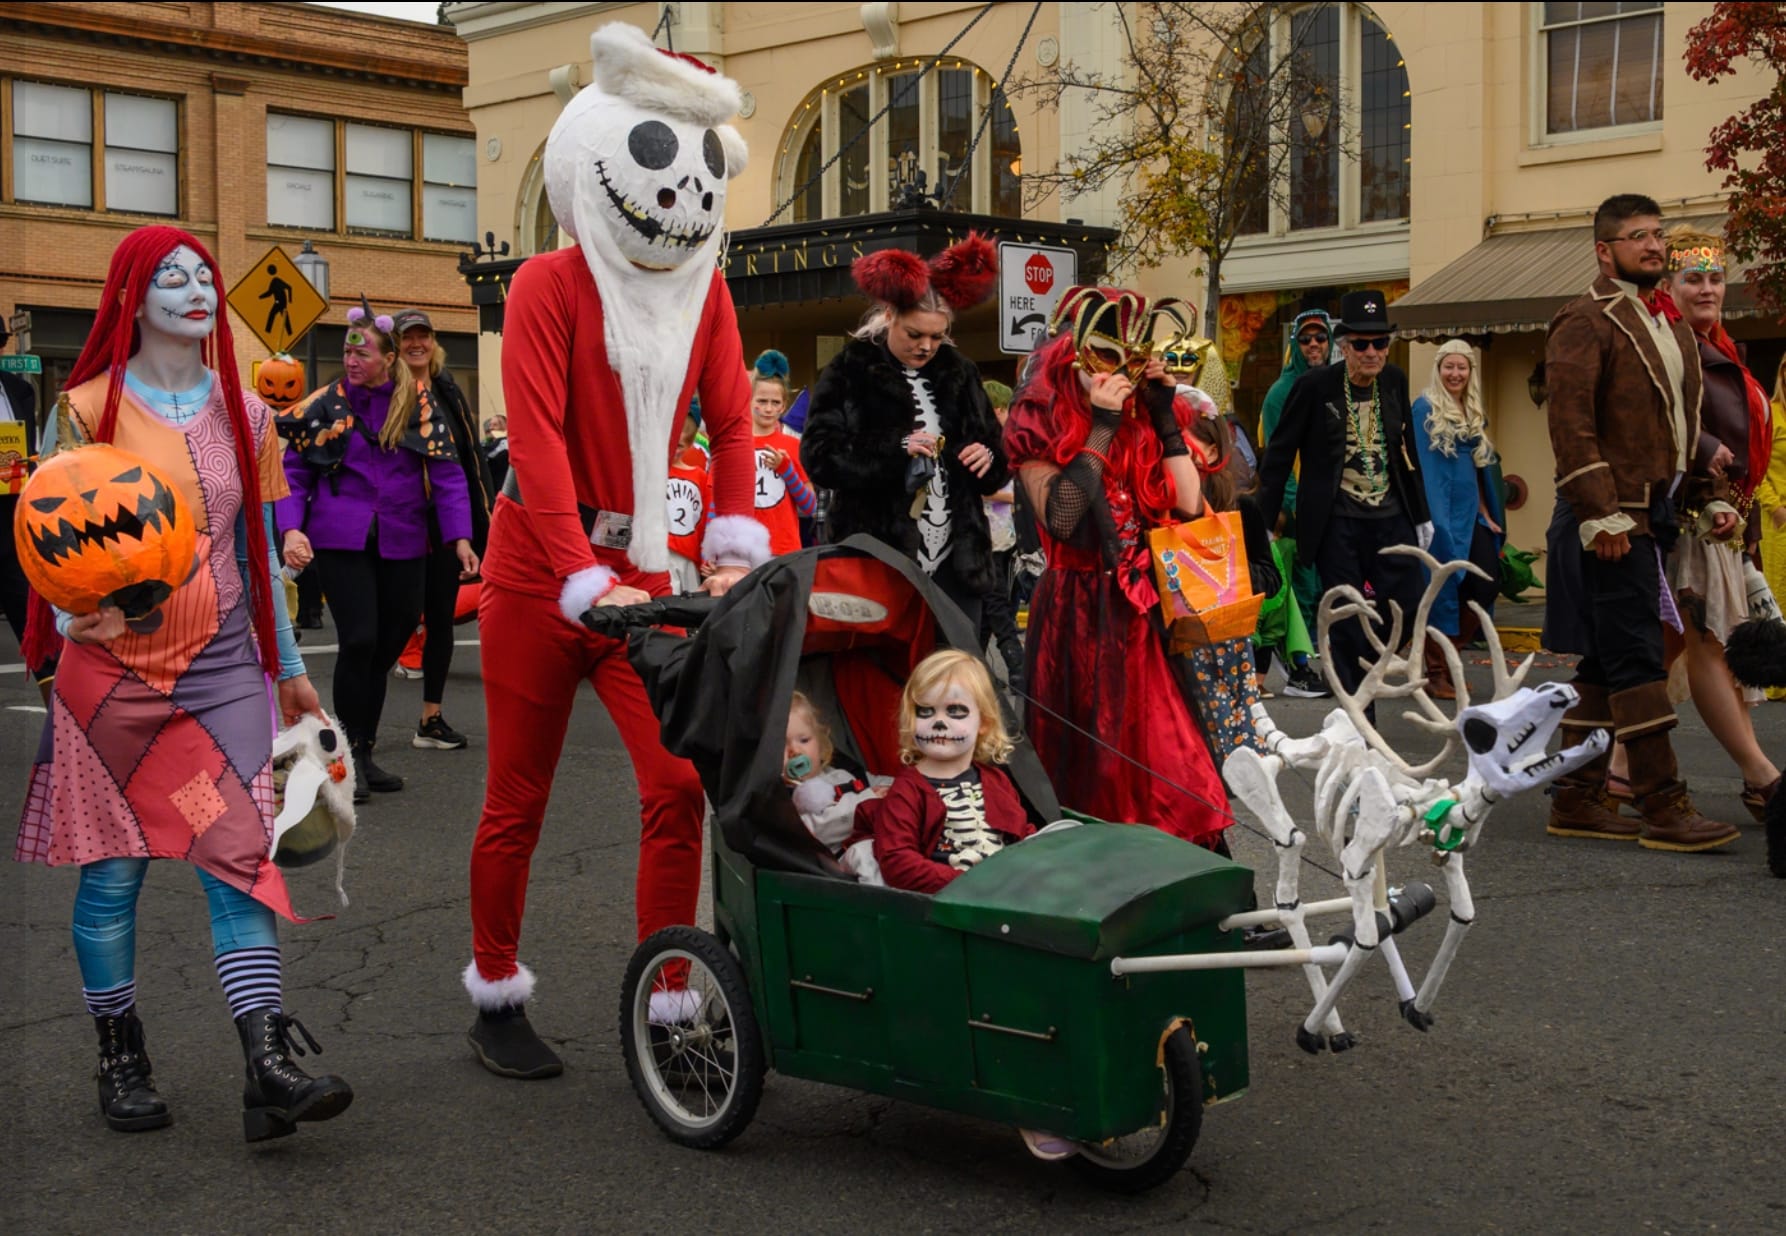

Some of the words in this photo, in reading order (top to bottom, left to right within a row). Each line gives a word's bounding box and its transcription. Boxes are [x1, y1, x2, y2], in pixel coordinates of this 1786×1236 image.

[1026, 265, 1053, 283] STOP
[1009, 296, 1036, 311] HERE
[756, 476, 768, 496] 1
[673, 507, 687, 527] 2
